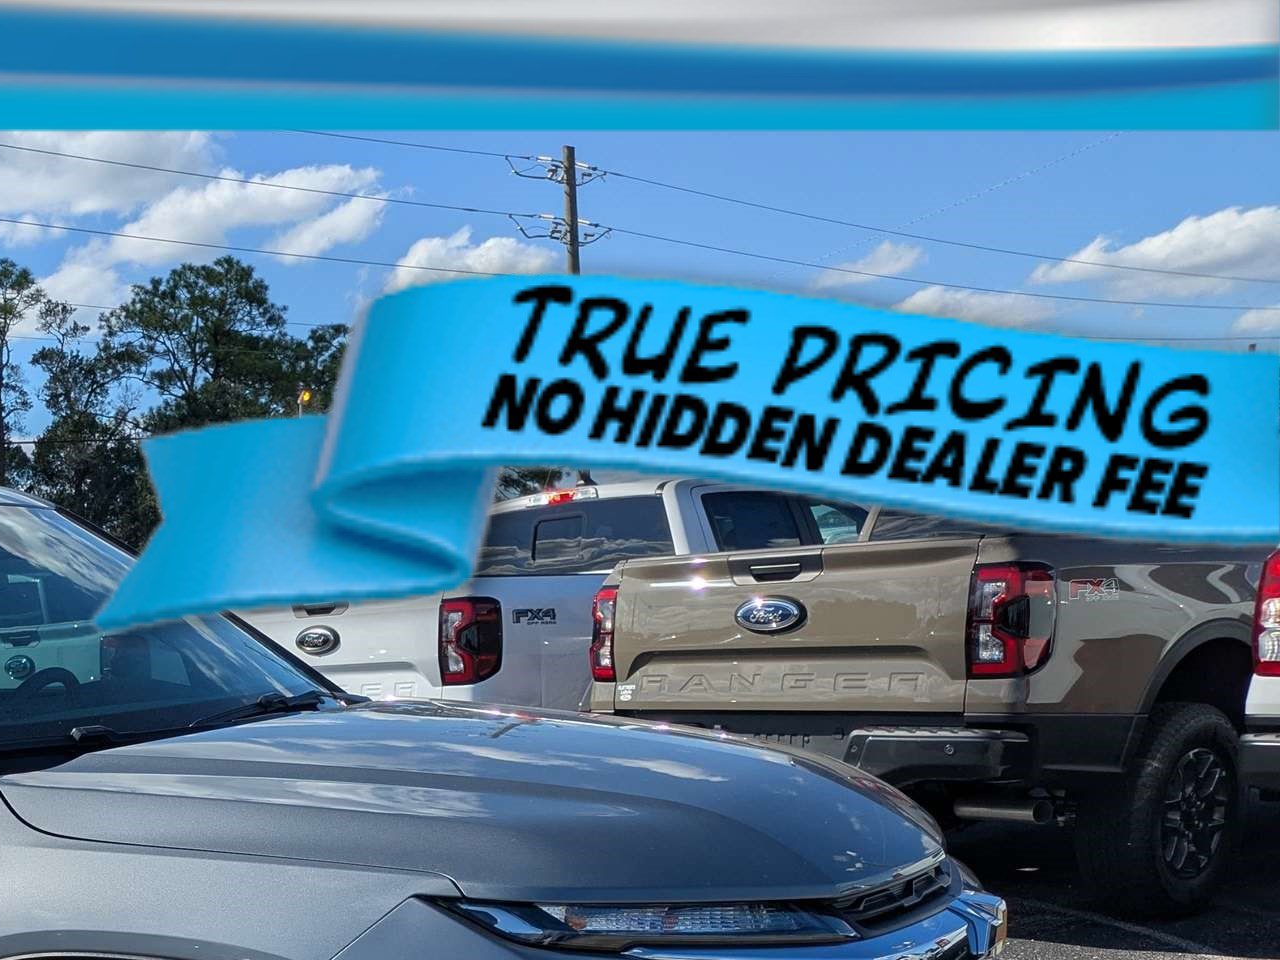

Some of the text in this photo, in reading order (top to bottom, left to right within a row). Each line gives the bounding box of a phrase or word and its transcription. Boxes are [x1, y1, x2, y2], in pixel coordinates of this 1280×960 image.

[1069, 577, 1120, 599] FX4
[511, 608, 557, 624] FX4
[639, 671, 926, 694] RANGER
